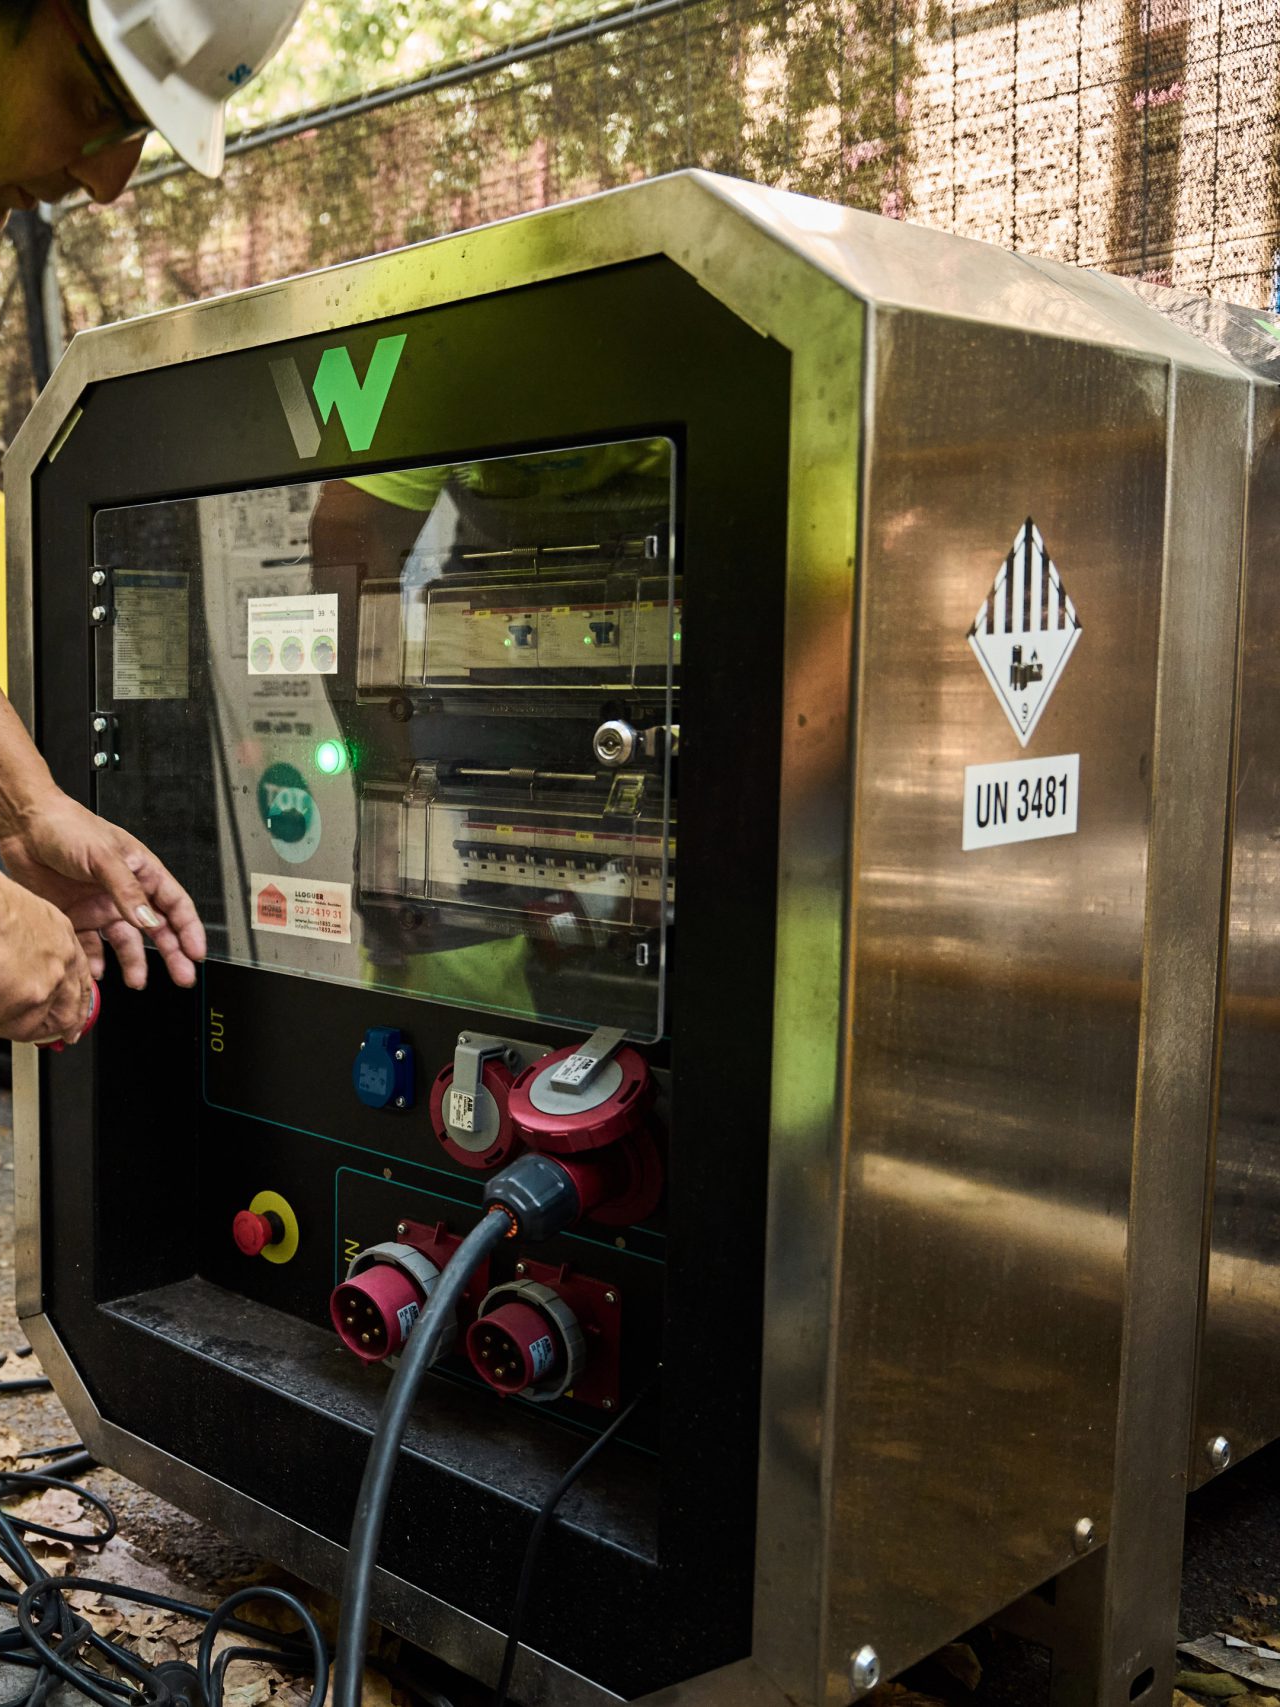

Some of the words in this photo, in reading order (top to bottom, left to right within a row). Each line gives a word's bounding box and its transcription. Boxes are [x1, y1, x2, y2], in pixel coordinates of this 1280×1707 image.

[976, 781, 1008, 829] UN
[1017, 773, 1068, 822] 3481
[294, 891, 324, 901] LLOGUER
[294, 905, 304, 915] 93
[333, 910, 342, 919] 31
[210, 1007, 224, 1052] OUT
